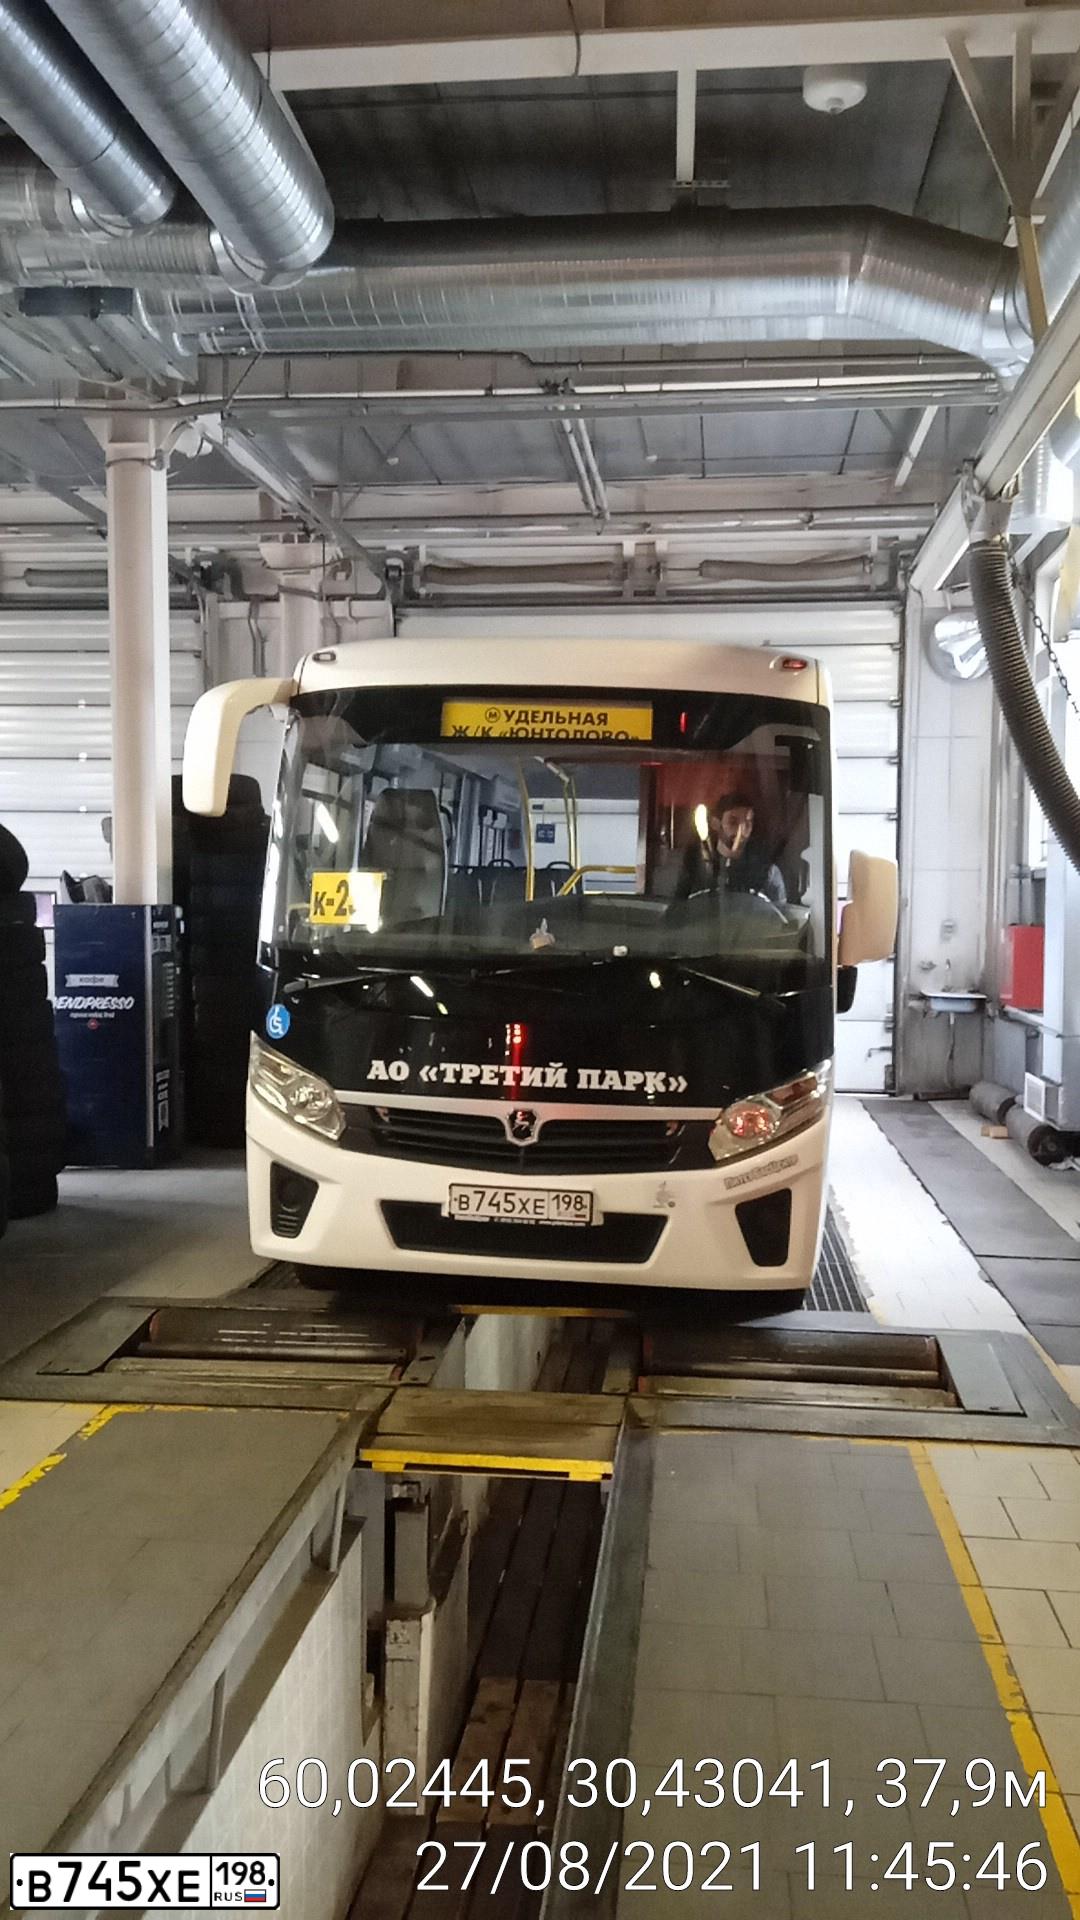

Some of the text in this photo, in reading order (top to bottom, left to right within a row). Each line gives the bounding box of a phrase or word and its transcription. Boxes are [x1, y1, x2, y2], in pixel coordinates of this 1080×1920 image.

[503, 709, 608, 726] УДЕЛЬНАЯ
[313, 880, 356, 917] К-2
[367, 1060, 688, 1093] АО «ТРЕТИЙ ПАРК»
[458, 1190, 583, 1215] В745ХЕ 198
